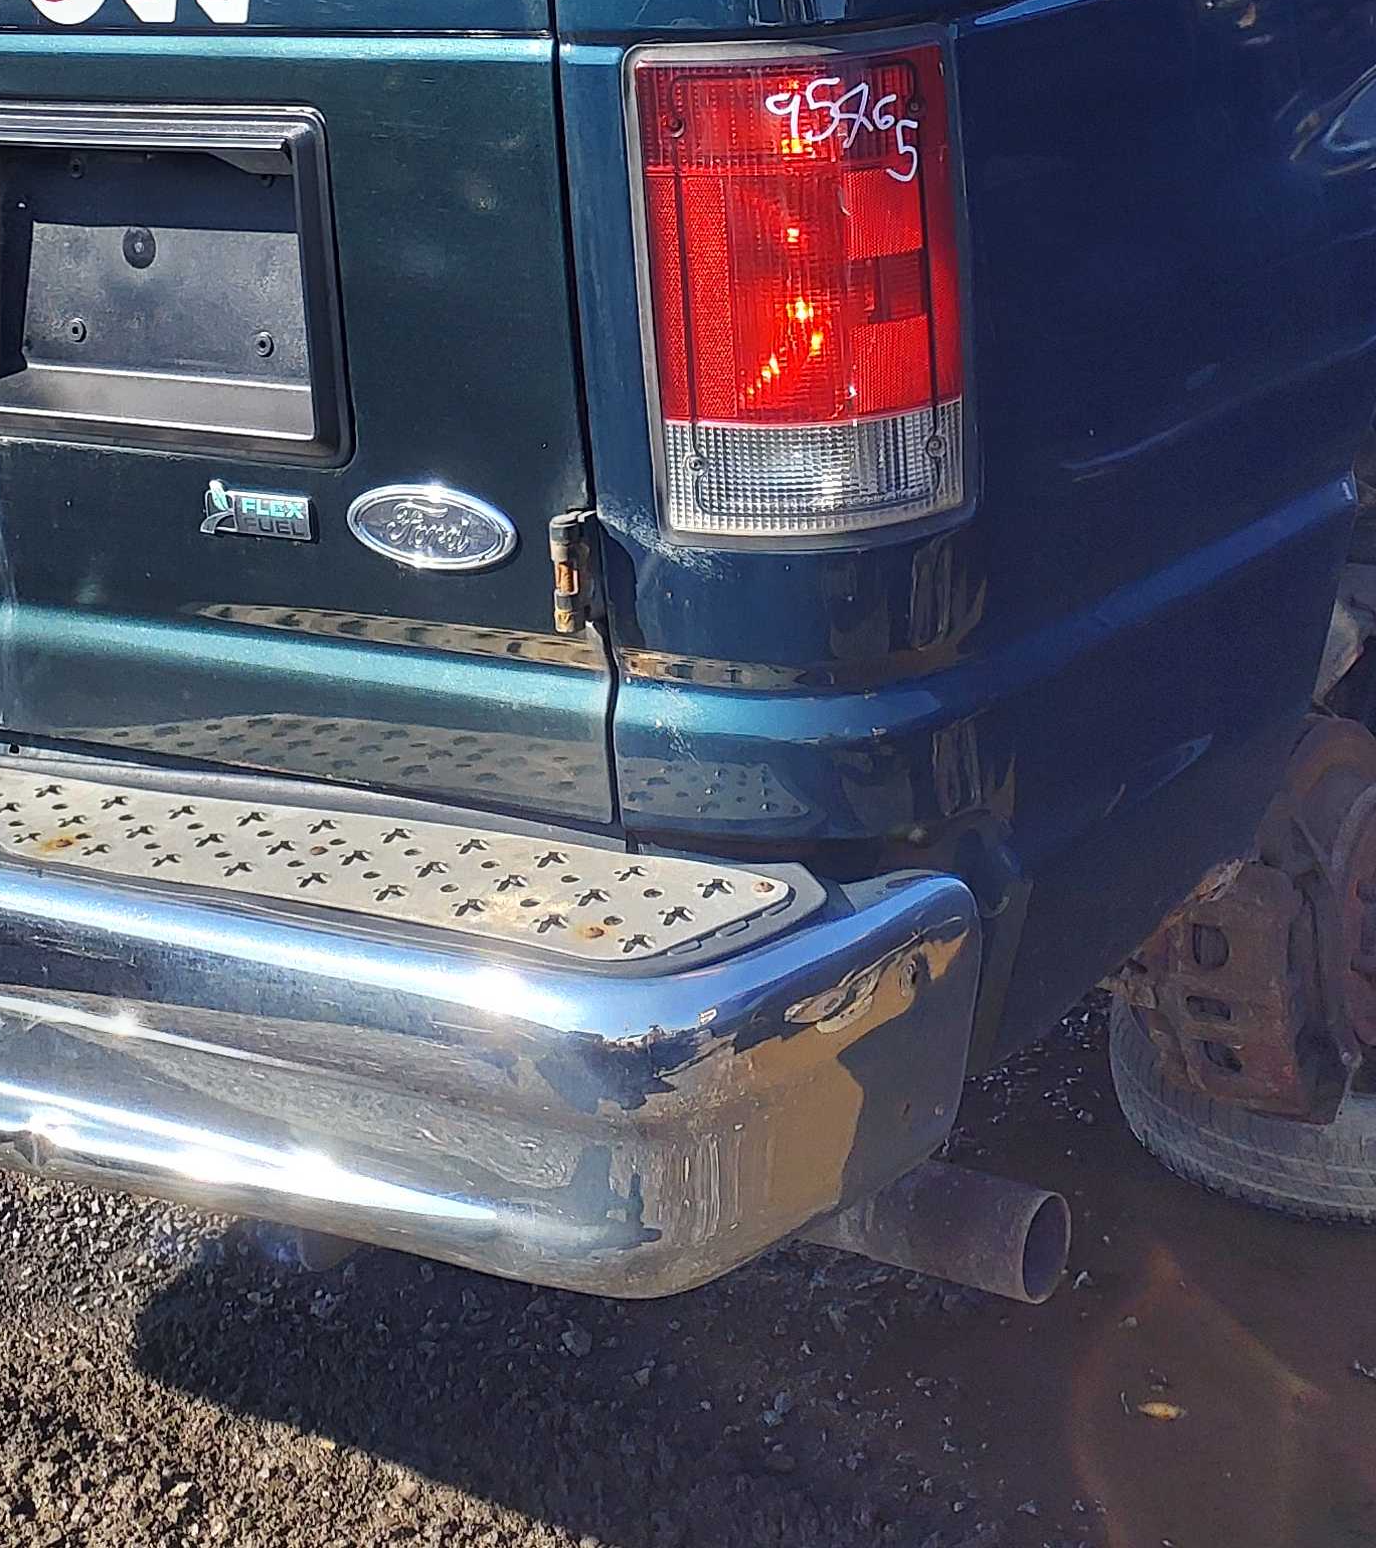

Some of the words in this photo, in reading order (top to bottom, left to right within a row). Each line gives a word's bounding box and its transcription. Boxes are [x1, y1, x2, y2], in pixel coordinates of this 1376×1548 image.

[241, 497, 305, 520] FLEX
[243, 517, 306, 537] FUEL
[385, 501, 471, 553] Ford
